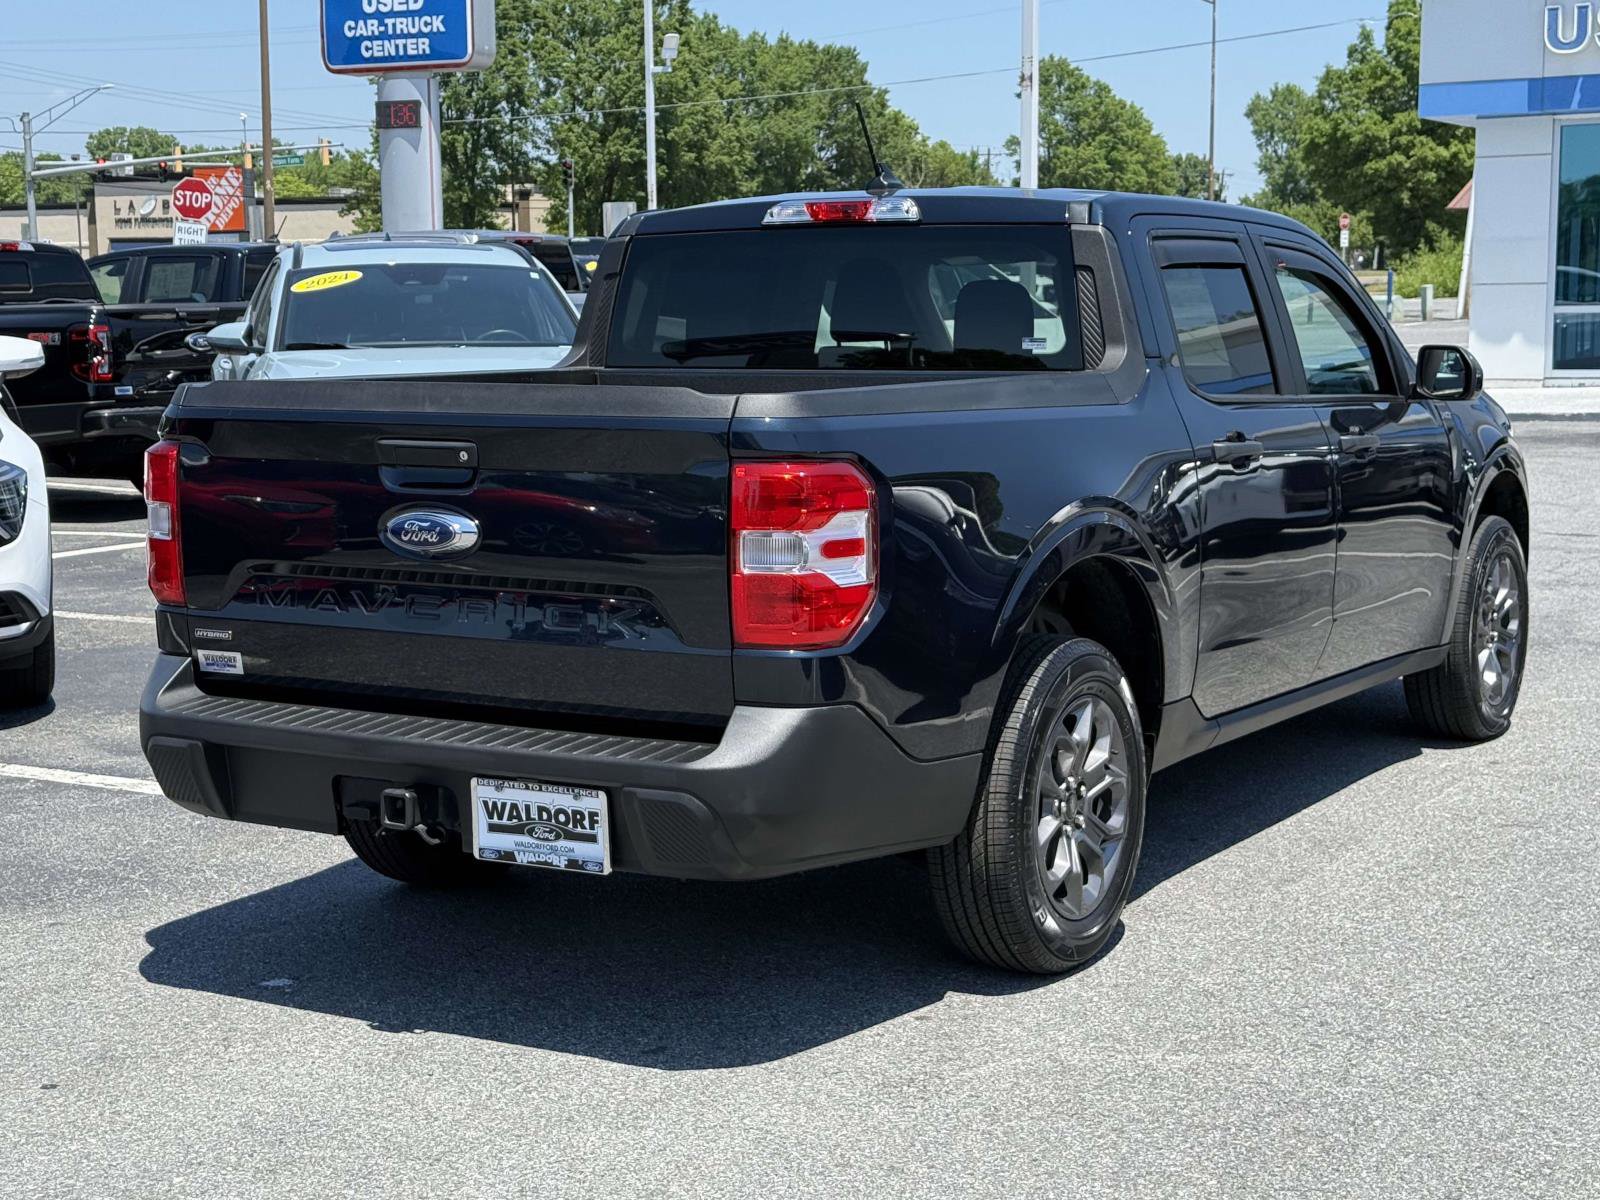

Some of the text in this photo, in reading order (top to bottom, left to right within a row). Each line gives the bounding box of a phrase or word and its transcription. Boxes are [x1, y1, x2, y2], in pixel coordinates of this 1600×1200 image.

[362, 0, 424, 14] USED
[344, 15, 446, 37] CAR-TRUCK
[1544, 2, 1600, 54] U
[361, 38, 431, 58] CENTER
[175, 190, 212, 208] STOP
[177, 226, 205, 237] RIGHT
[305, 273, 349, 289] 2024
[401, 520, 440, 542] Ford
[255, 586, 650, 640] MAVERICK
[196, 629, 230, 639] HYBRID
[202, 654, 238, 663] WALDORF
[478, 779, 599, 798] DEDICATED TO EXCELLENCE
[481, 799, 600, 831] WALDORF
[532, 826, 556, 840] Ford
[482, 850, 498, 859] Ford
[514, 840, 575, 854] WALDORFFORD.COM
[513, 850, 568, 868] WALDORF
[585, 863, 601, 871] Ford
